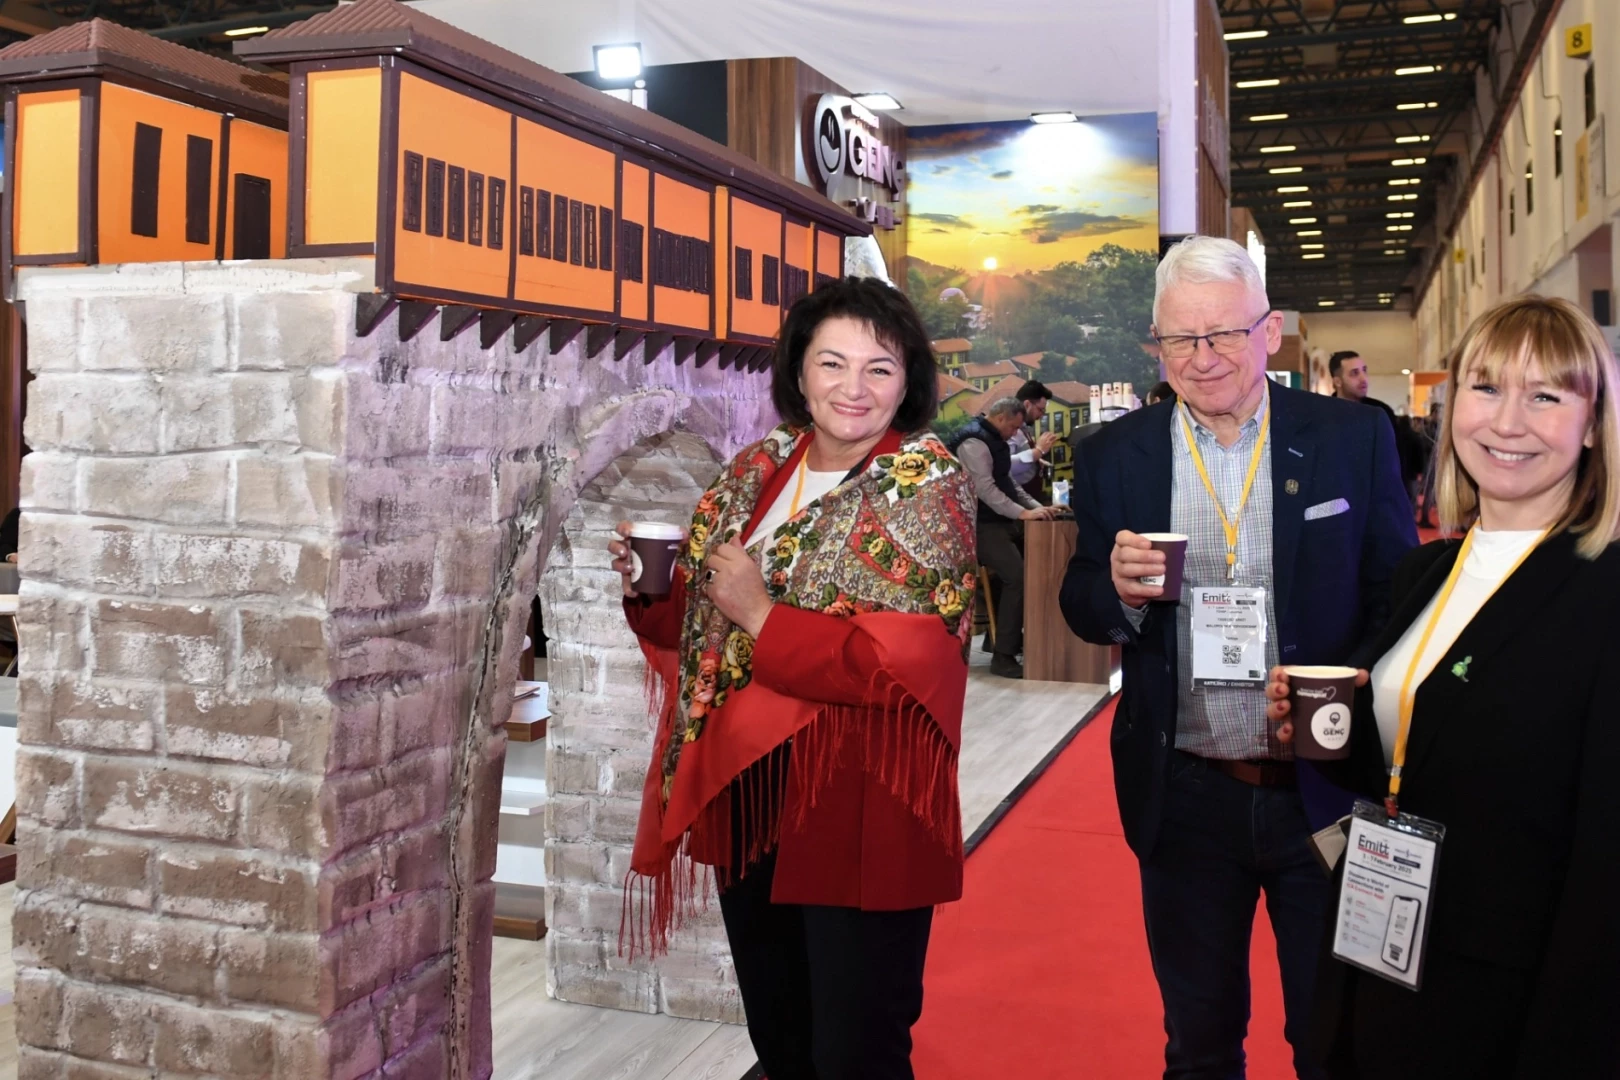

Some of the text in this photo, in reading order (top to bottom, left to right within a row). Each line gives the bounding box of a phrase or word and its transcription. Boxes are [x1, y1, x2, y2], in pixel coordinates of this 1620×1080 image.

[1572, 31, 1584, 48] 8
[1323, 728, 1344, 736] GENÇ
[1358, 834, 1390, 856] Emitt
